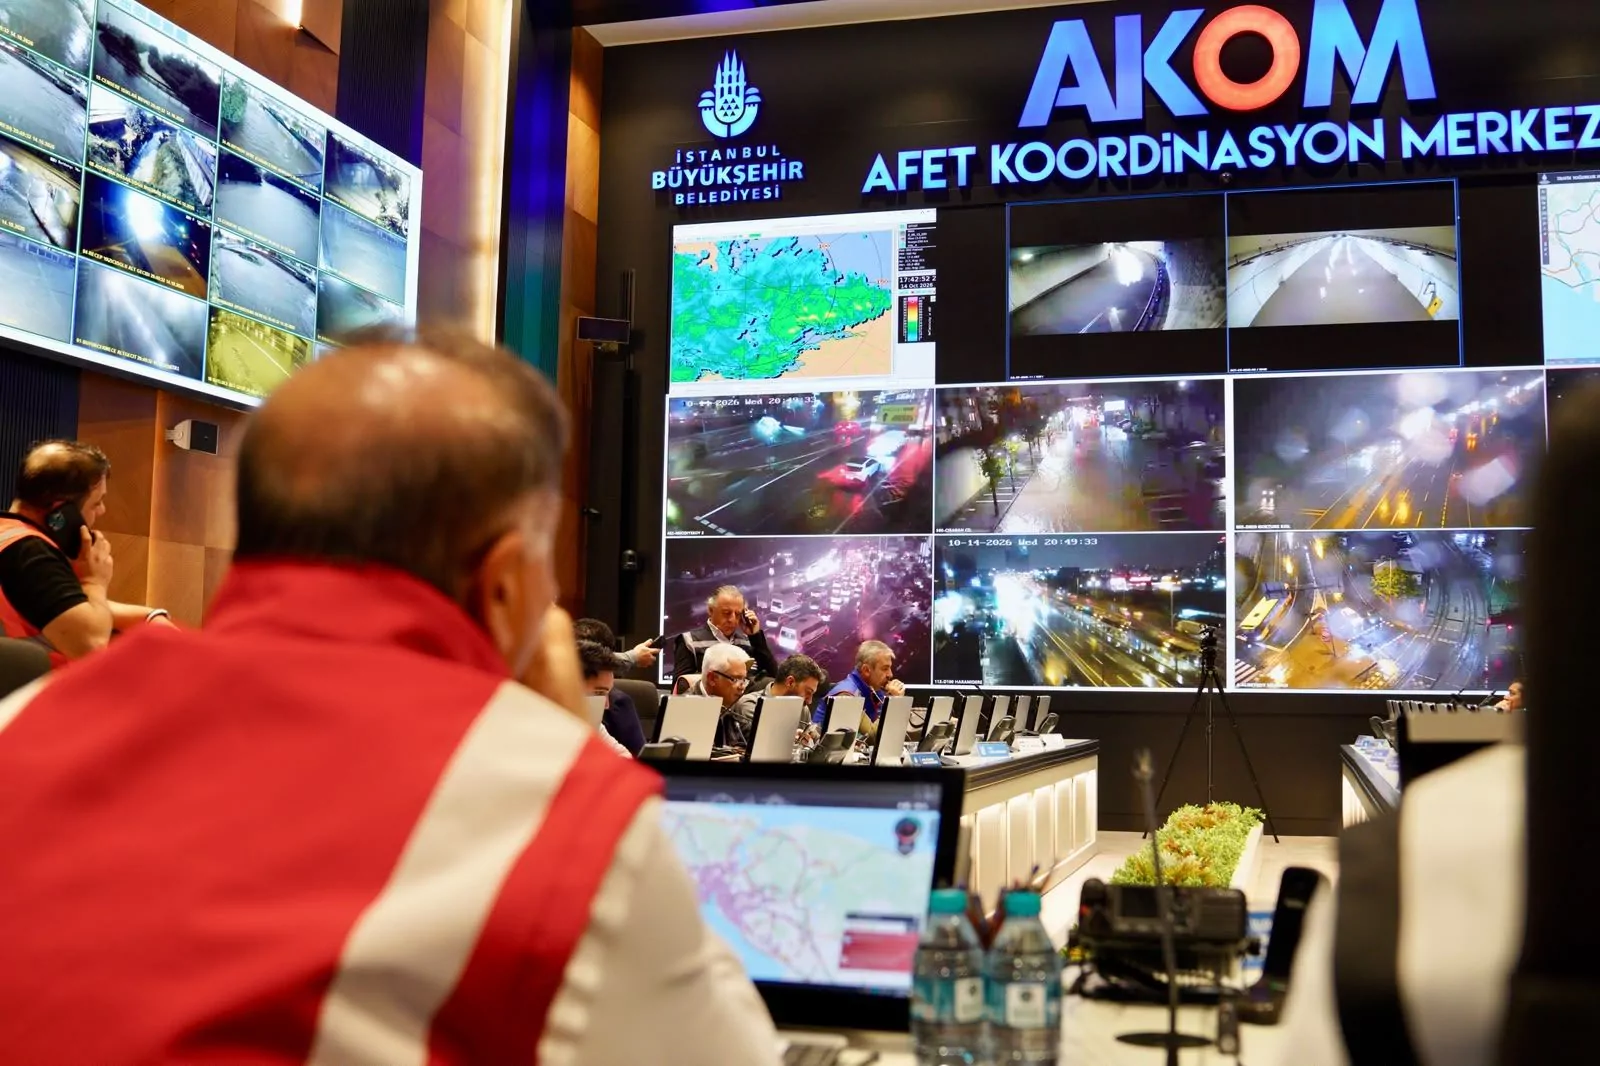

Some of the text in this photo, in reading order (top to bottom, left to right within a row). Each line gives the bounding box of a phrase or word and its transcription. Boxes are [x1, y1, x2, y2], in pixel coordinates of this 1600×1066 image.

[1017, 0, 1437, 127] AKOM
[676, 145, 780, 163] İSTANBUL
[861, 146, 976, 193] AFET
[1400, 105, 1600, 159] MERKEZ
[652, 159, 803, 190] BÜYÜKŞEHİR
[675, 184, 779, 205] BELEDİYESİ
[948, 539, 1012, 547] 10-14-2026
[1044, 538, 1098, 546] 20:49:33
